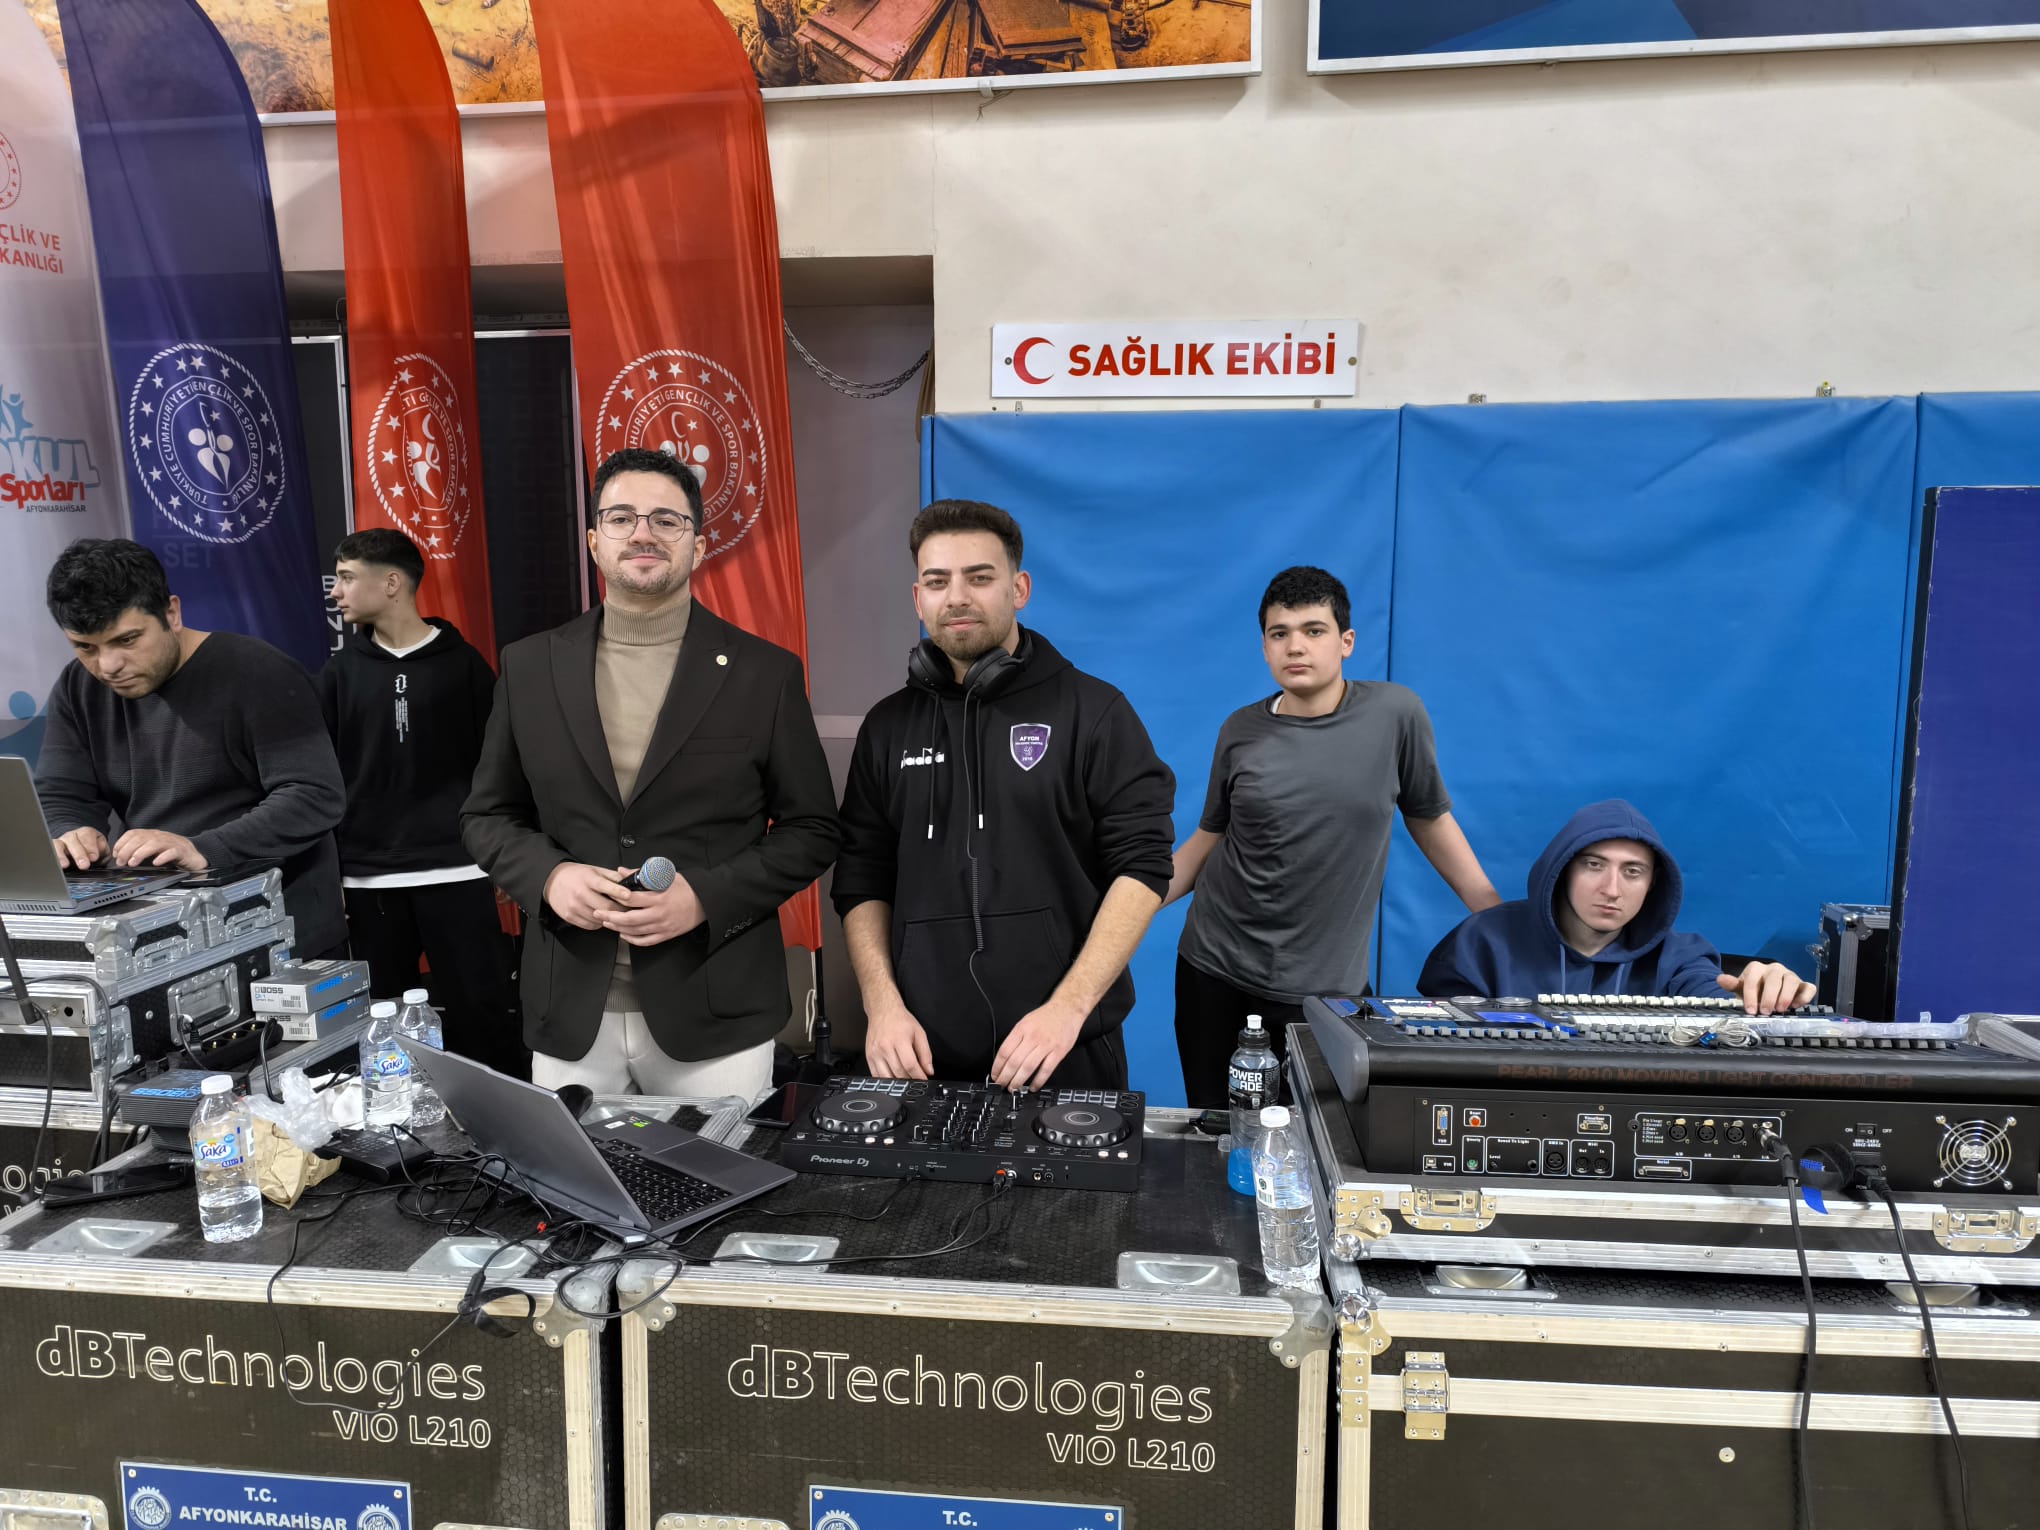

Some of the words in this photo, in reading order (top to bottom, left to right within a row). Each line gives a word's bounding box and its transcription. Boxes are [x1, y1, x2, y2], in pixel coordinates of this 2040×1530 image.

[40, 231, 61, 251] VE
[1067, 335, 1215, 377] SAĞLIK
[1226, 332, 1336, 376] EKİBİ
[233, 400, 245, 417] VE
[241, 416, 259, 449] SPOR
[711, 407, 724, 424] VE
[722, 423, 739, 460] SPOR
[1229, 1065, 1263, 1082] POWER
[1567, 1066, 1613, 1082] 2010
[1617, 1068, 1699, 1084] MOVING
[1770, 1072, 1913, 1089] CONTROLLER
[1240, 1080, 1262, 1092] ADE
[200, 1144, 227, 1161] Saka
[810, 1154, 856, 1165] Pioneer
[36, 1325, 485, 1409] dBTechnologies
[727, 1344, 1213, 1431] dBTechnologies
[332, 1410, 399, 1443] VIO
[408, 1414, 492, 1449] L210
[1046, 1432, 1116, 1466] VIO
[1127, 1437, 1216, 1473] L210
[243, 1486, 277, 1503] T.C.
[178, 1505, 348, 1530] AFYONKARAHİSAR
[942, 1510, 978, 1527] T.C.
